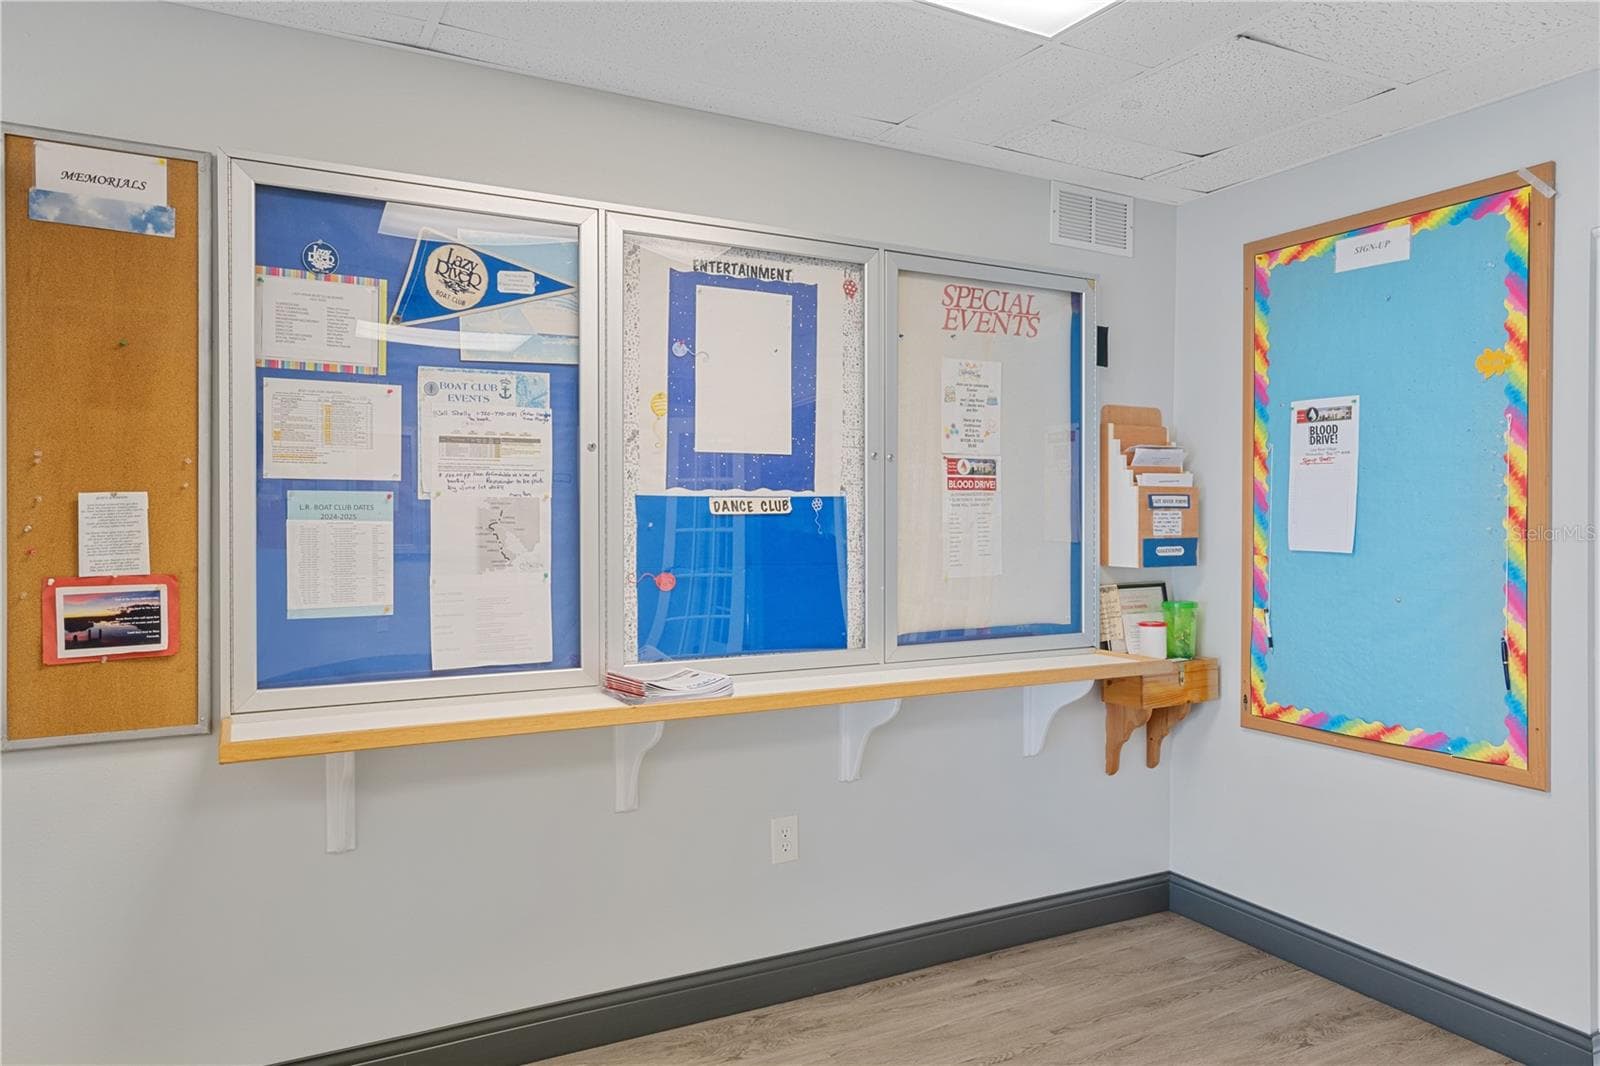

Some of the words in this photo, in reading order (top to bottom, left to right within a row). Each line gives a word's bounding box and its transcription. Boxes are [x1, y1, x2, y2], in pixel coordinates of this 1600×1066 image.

[60, 170, 148, 191] MEMORIALS
[1353, 240, 1391, 255] SIGN-UP
[447, 247, 479, 271] Lazy
[693, 259, 793, 282] ENTERTAINMENT
[435, 289, 451, 299] BOAT
[452, 296, 466, 306] CLUB
[942, 284, 1041, 316] SPECIAL
[942, 307, 1041, 338] EVENTS
[439, 382, 468, 391] BOAT
[470, 383, 498, 393] CLUB
[447, 393, 491, 403] EVENTS
[1309, 424, 1339, 436] BLOOD
[1309, 434, 1339, 445] DRIVE!
[948, 479, 974, 489] BLOOD
[314, 503, 333, 511] BOAT
[333, 503, 352, 511] CLUB
[353, 503, 375, 511] DATES
[713, 500, 754, 513] DANCE
[760, 499, 790, 512] CLUB
[320, 513, 358, 521] 2024-2025
